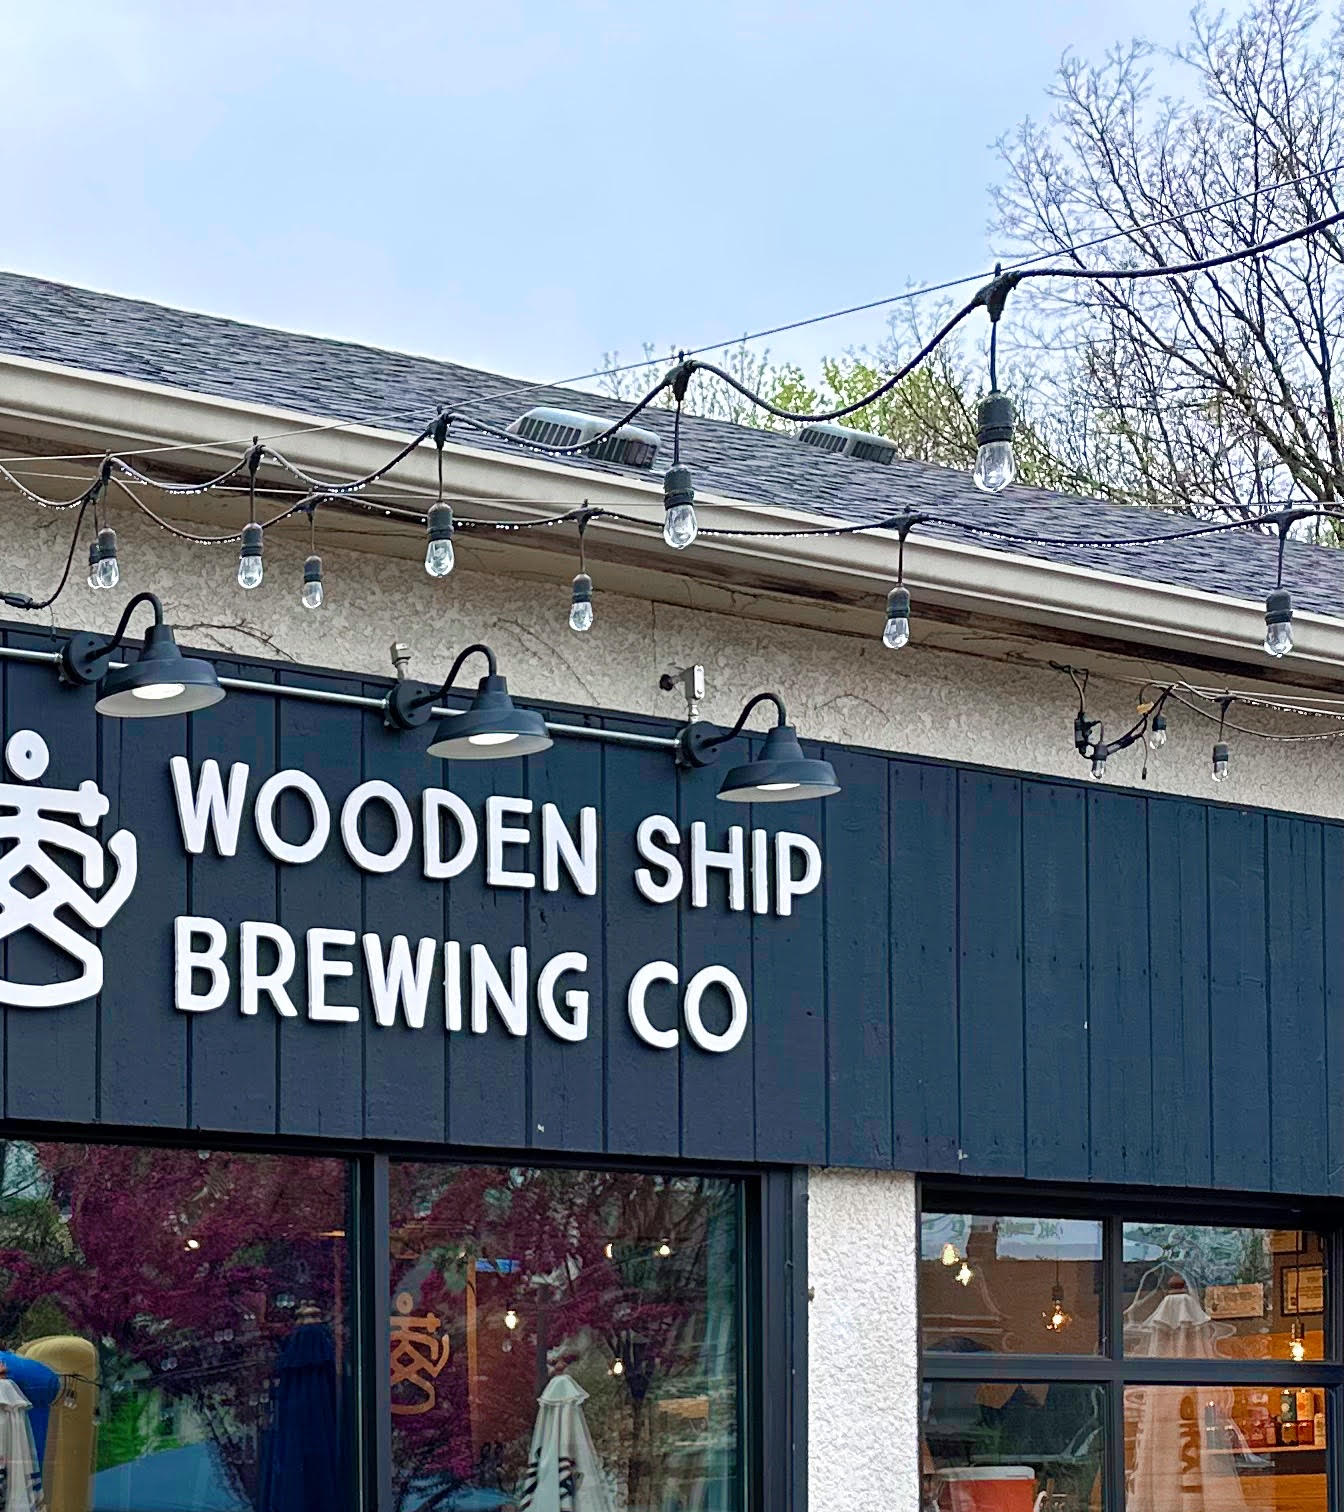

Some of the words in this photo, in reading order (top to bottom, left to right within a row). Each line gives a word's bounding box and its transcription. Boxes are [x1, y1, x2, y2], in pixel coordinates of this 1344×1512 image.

[169, 756, 598, 896] WOODEN
[634, 815, 823, 917] SHIP
[174, 915, 590, 1043] BREWING
[627, 960, 749, 1054] CO
